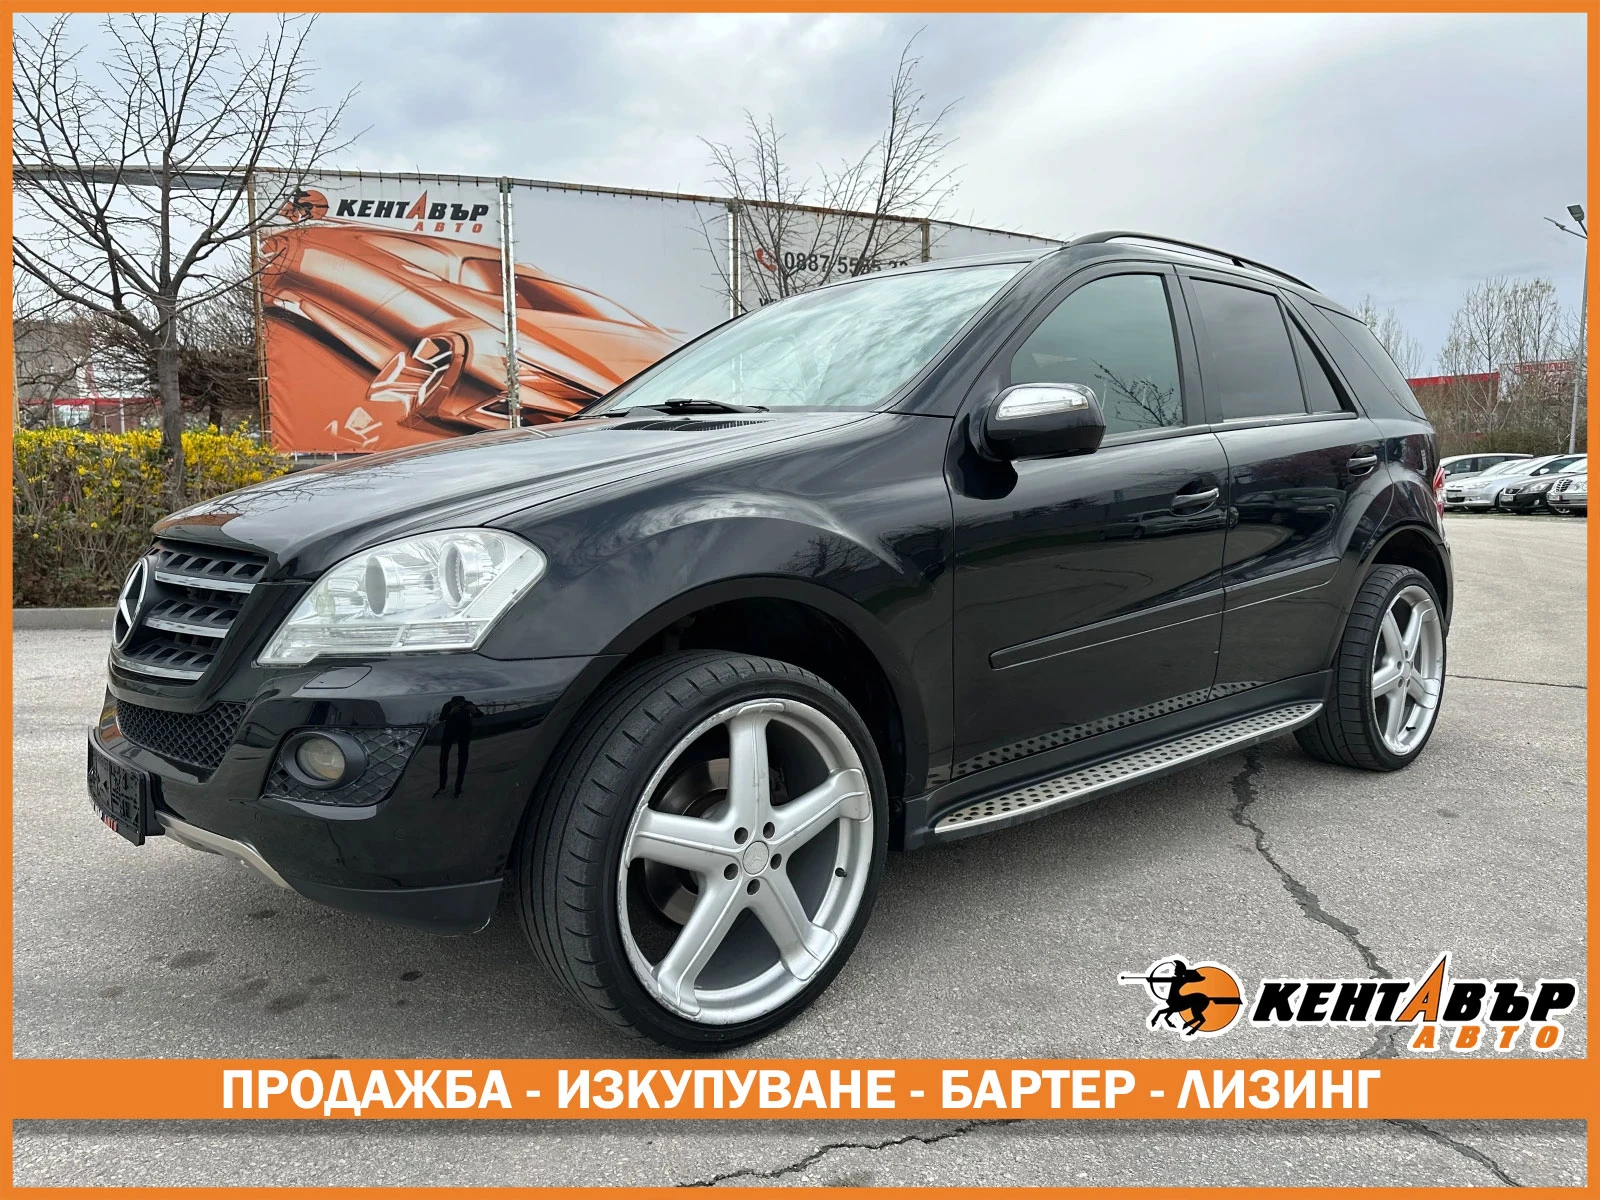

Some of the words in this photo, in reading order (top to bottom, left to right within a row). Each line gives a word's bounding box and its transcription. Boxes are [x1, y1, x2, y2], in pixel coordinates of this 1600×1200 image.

[336, 190, 489, 221] КЕНТАВЪР
[413, 221, 483, 233] АВТО
[784, 252, 830, 272] 0887
